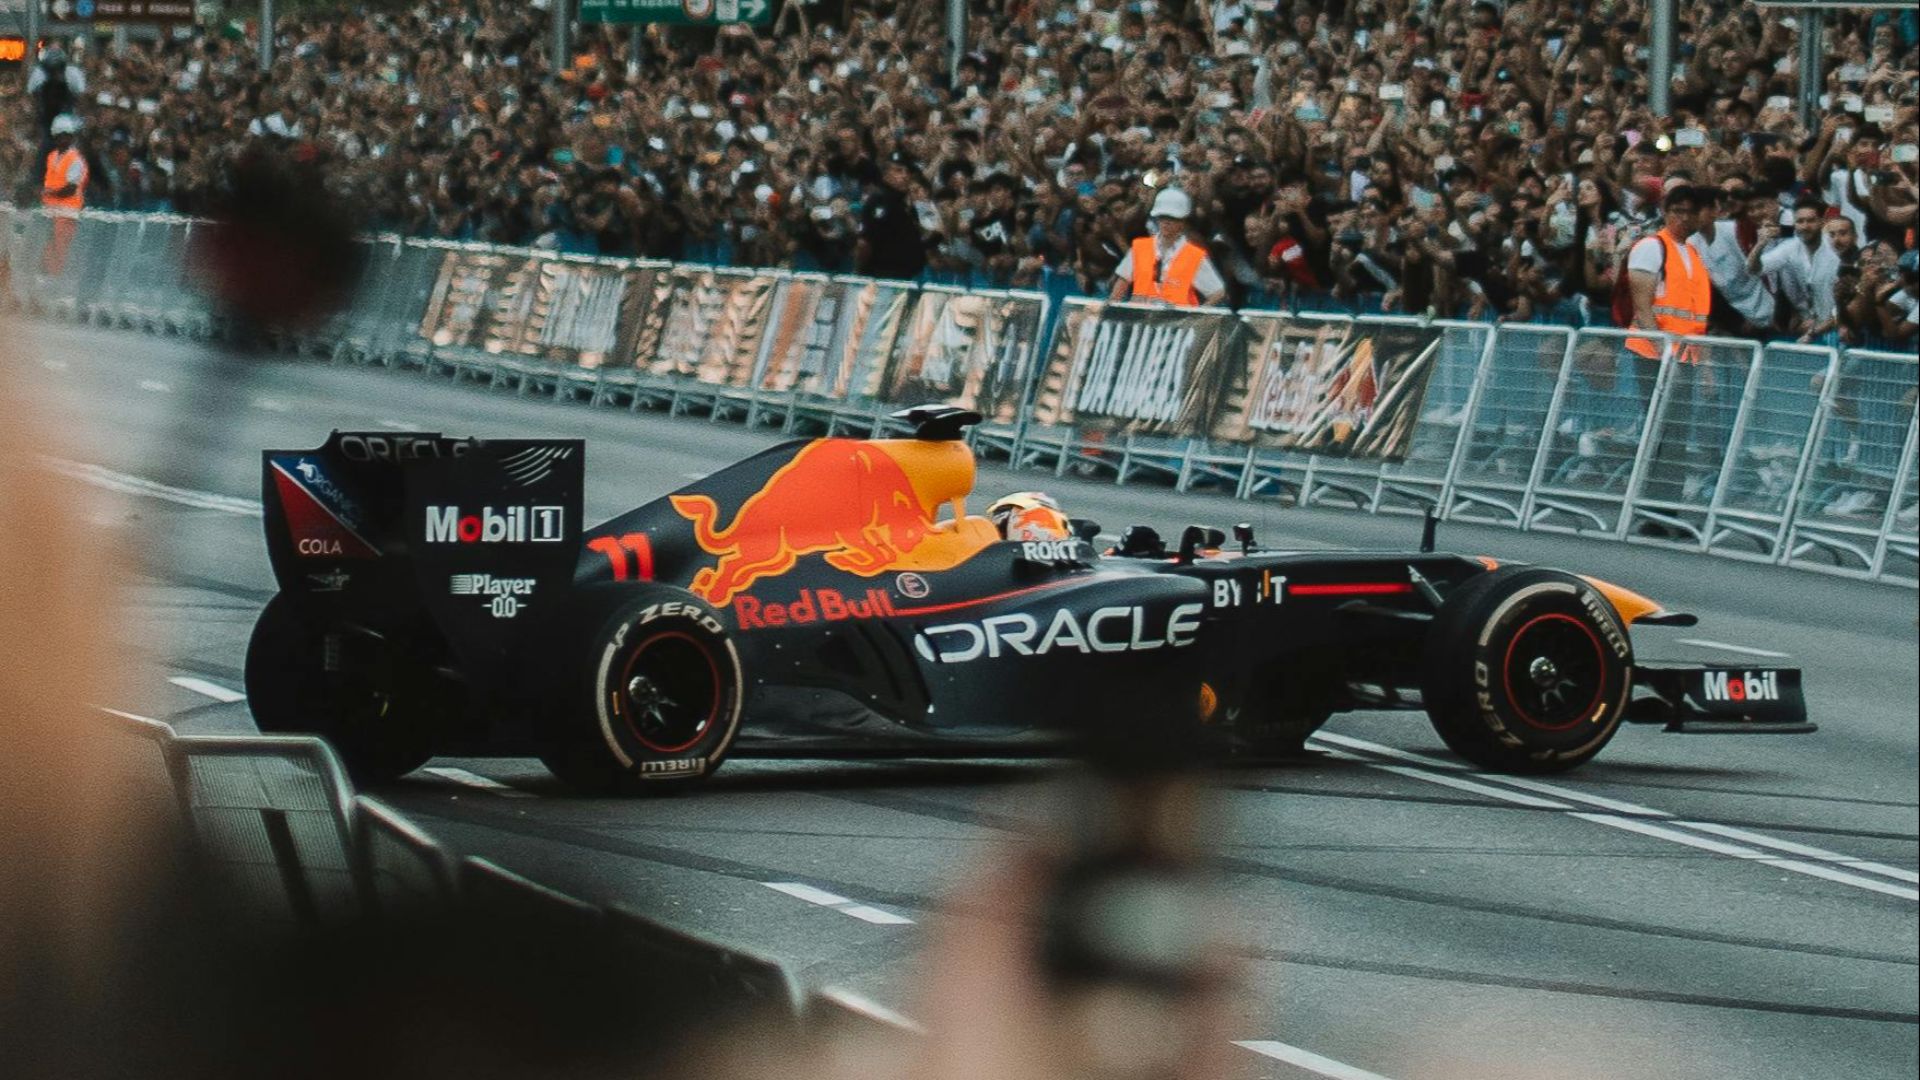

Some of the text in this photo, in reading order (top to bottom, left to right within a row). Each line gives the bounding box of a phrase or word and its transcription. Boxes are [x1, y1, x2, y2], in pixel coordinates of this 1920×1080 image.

[426, 506, 526, 542] Mobil
[299, 538, 343, 555] COLA
[586, 532, 654, 582] 11
[1022, 541, 1078, 561] ROKT
[471, 574, 536, 598] Player
[640, 602, 723, 634] ZERO
[734, 588, 896, 630] Red Bull
[914, 602, 1204, 663] ORACLE
[1703, 671, 1779, 703] Mobil
[641, 758, 706, 779] PIRELLI
